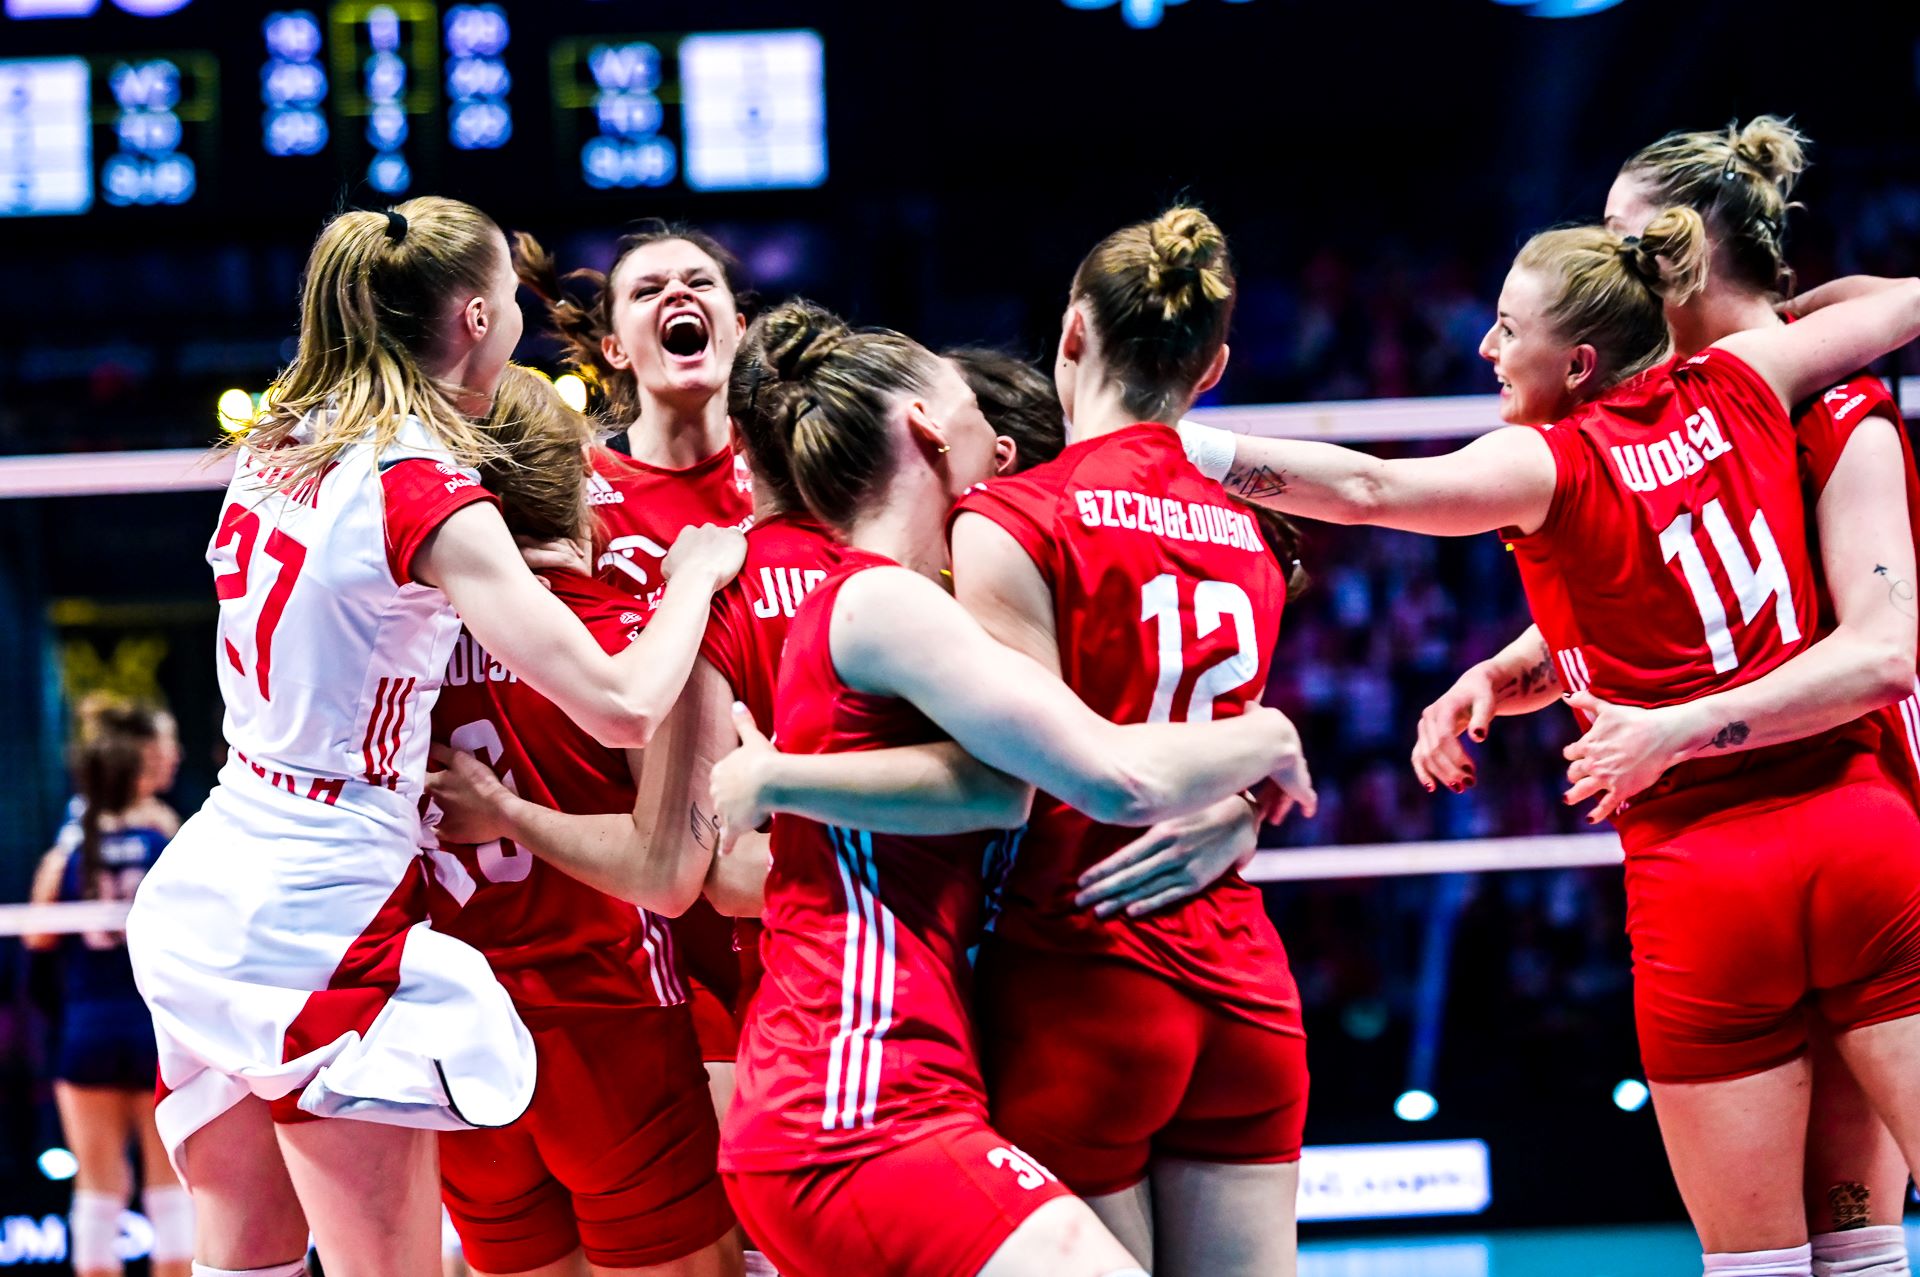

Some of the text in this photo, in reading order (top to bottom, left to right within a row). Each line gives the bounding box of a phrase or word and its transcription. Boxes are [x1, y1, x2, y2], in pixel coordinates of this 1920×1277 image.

[214, 502, 308, 703] 27
[1140, 573, 1260, 724] 12
[1658, 497, 1802, 675] 14
